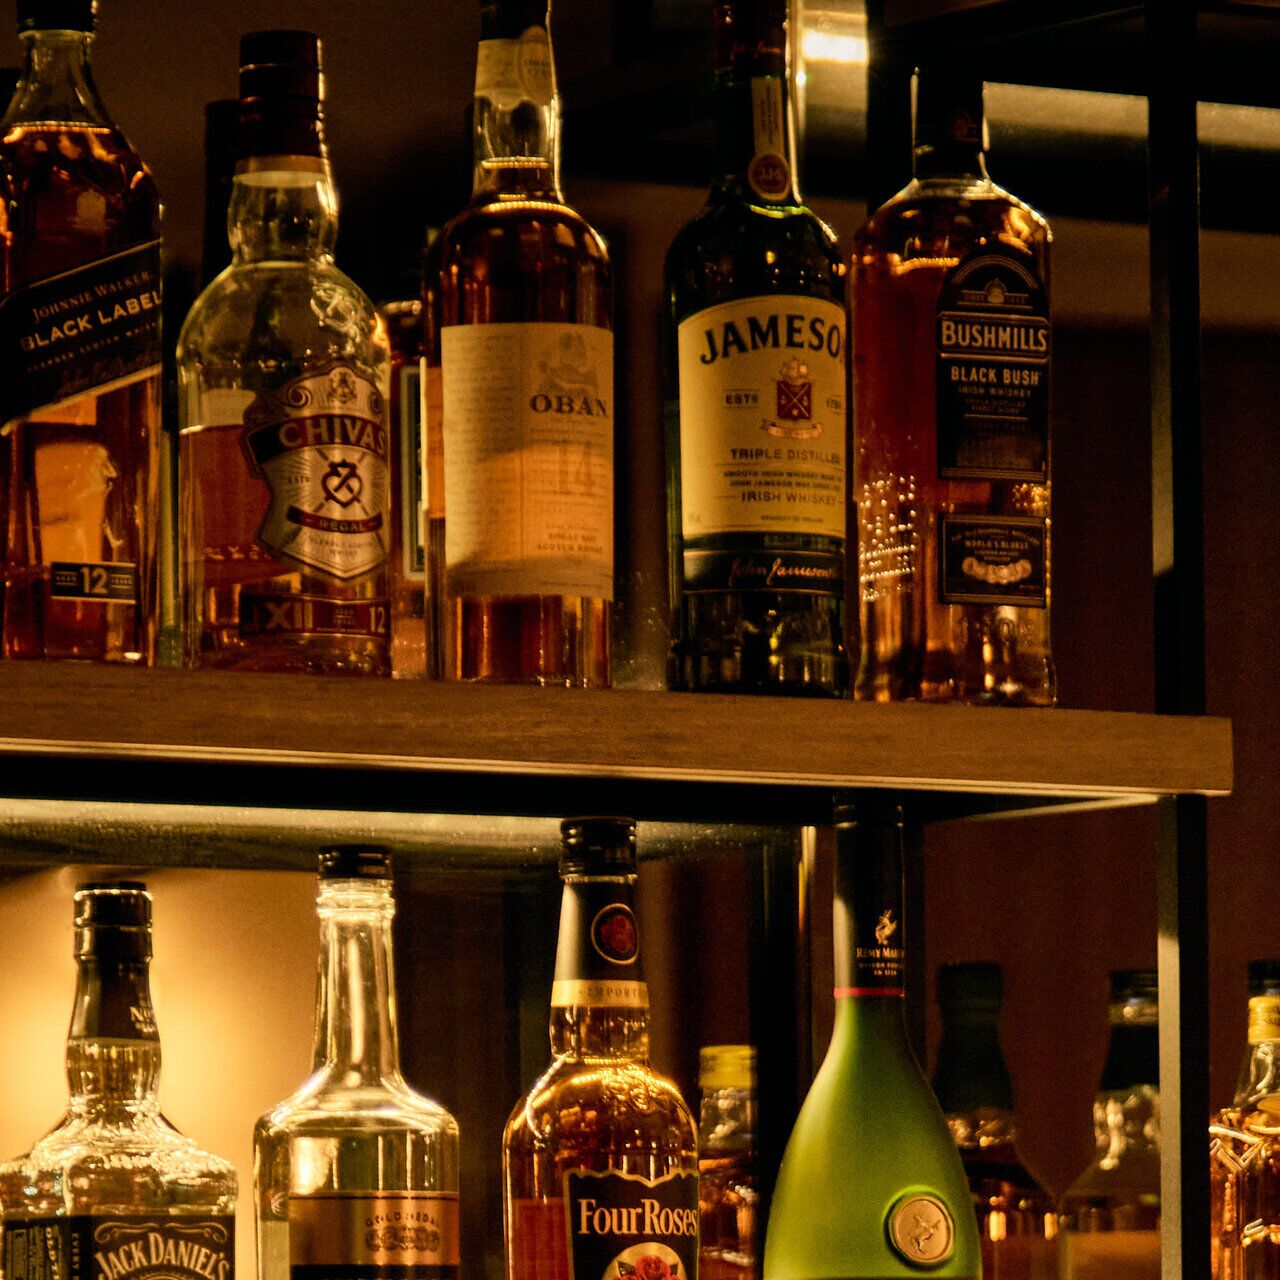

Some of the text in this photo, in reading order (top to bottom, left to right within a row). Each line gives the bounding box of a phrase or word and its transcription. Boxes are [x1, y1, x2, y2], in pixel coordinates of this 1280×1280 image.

[21, 312, 94, 352] BLACK
[97, 289, 162, 326] LABEL
[700, 314, 841, 365] JAMESO
[940, 320, 1048, 352] BUSHMILLS
[950, 365, 1040, 386] BLACK BUSH
[529, 393, 608, 416] OBAN
[277, 417, 386, 455] CHIVAS
[730, 448, 782, 461] TRIPLE
[320, 520, 366, 532] REGAL
[80, 566, 107, 594] 12
[365, 1211, 401, 1227] GOLD
[578, 1199, 698, 1237] Four Roses
